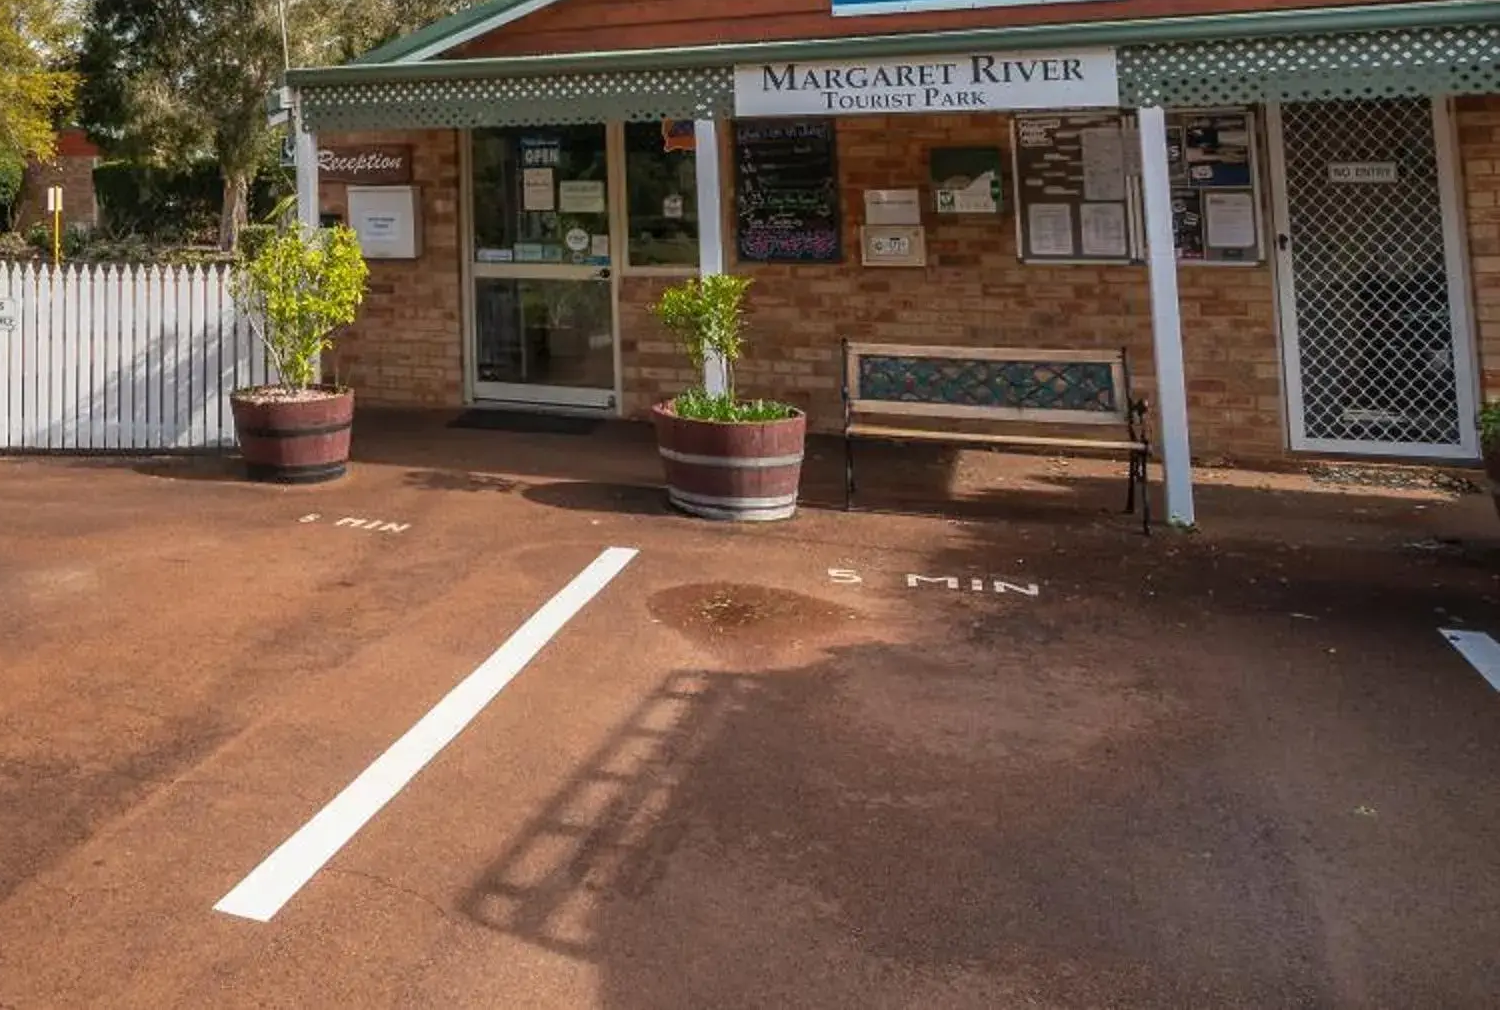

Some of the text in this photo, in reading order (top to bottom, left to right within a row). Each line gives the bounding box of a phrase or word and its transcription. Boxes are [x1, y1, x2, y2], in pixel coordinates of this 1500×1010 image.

[761, 55, 1085, 92] MARGARET RIVER
[821, 88, 987, 110] TOURIST PARK
[318, 150, 403, 175] Reception
[525, 148, 559, 163] OPEN
[334, 517, 411, 532] MIN
[827, 568, 1039, 596] 5 MIN
